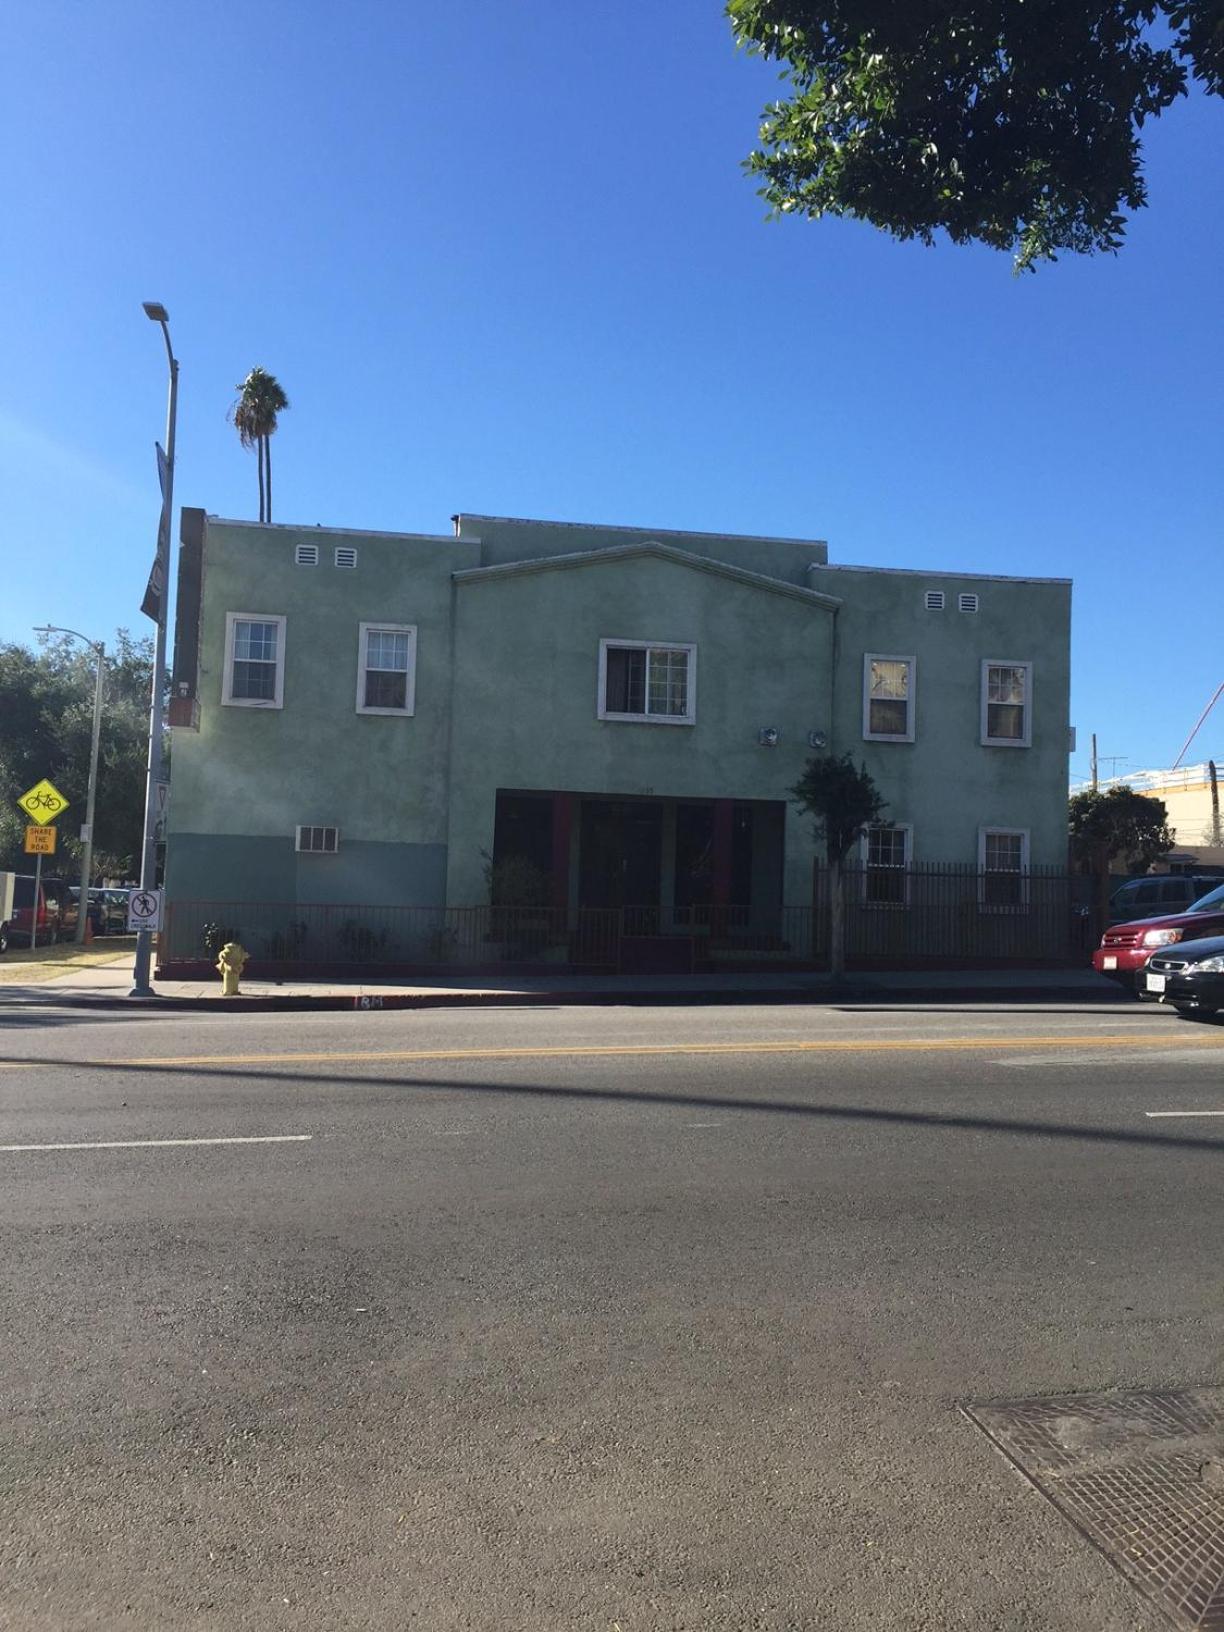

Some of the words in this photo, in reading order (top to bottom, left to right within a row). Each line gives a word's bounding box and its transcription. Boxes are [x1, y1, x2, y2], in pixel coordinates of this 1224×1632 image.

[30, 827, 52, 836] SHARE
[35, 835, 48, 843] THE
[30, 843, 49, 851] ROAD
